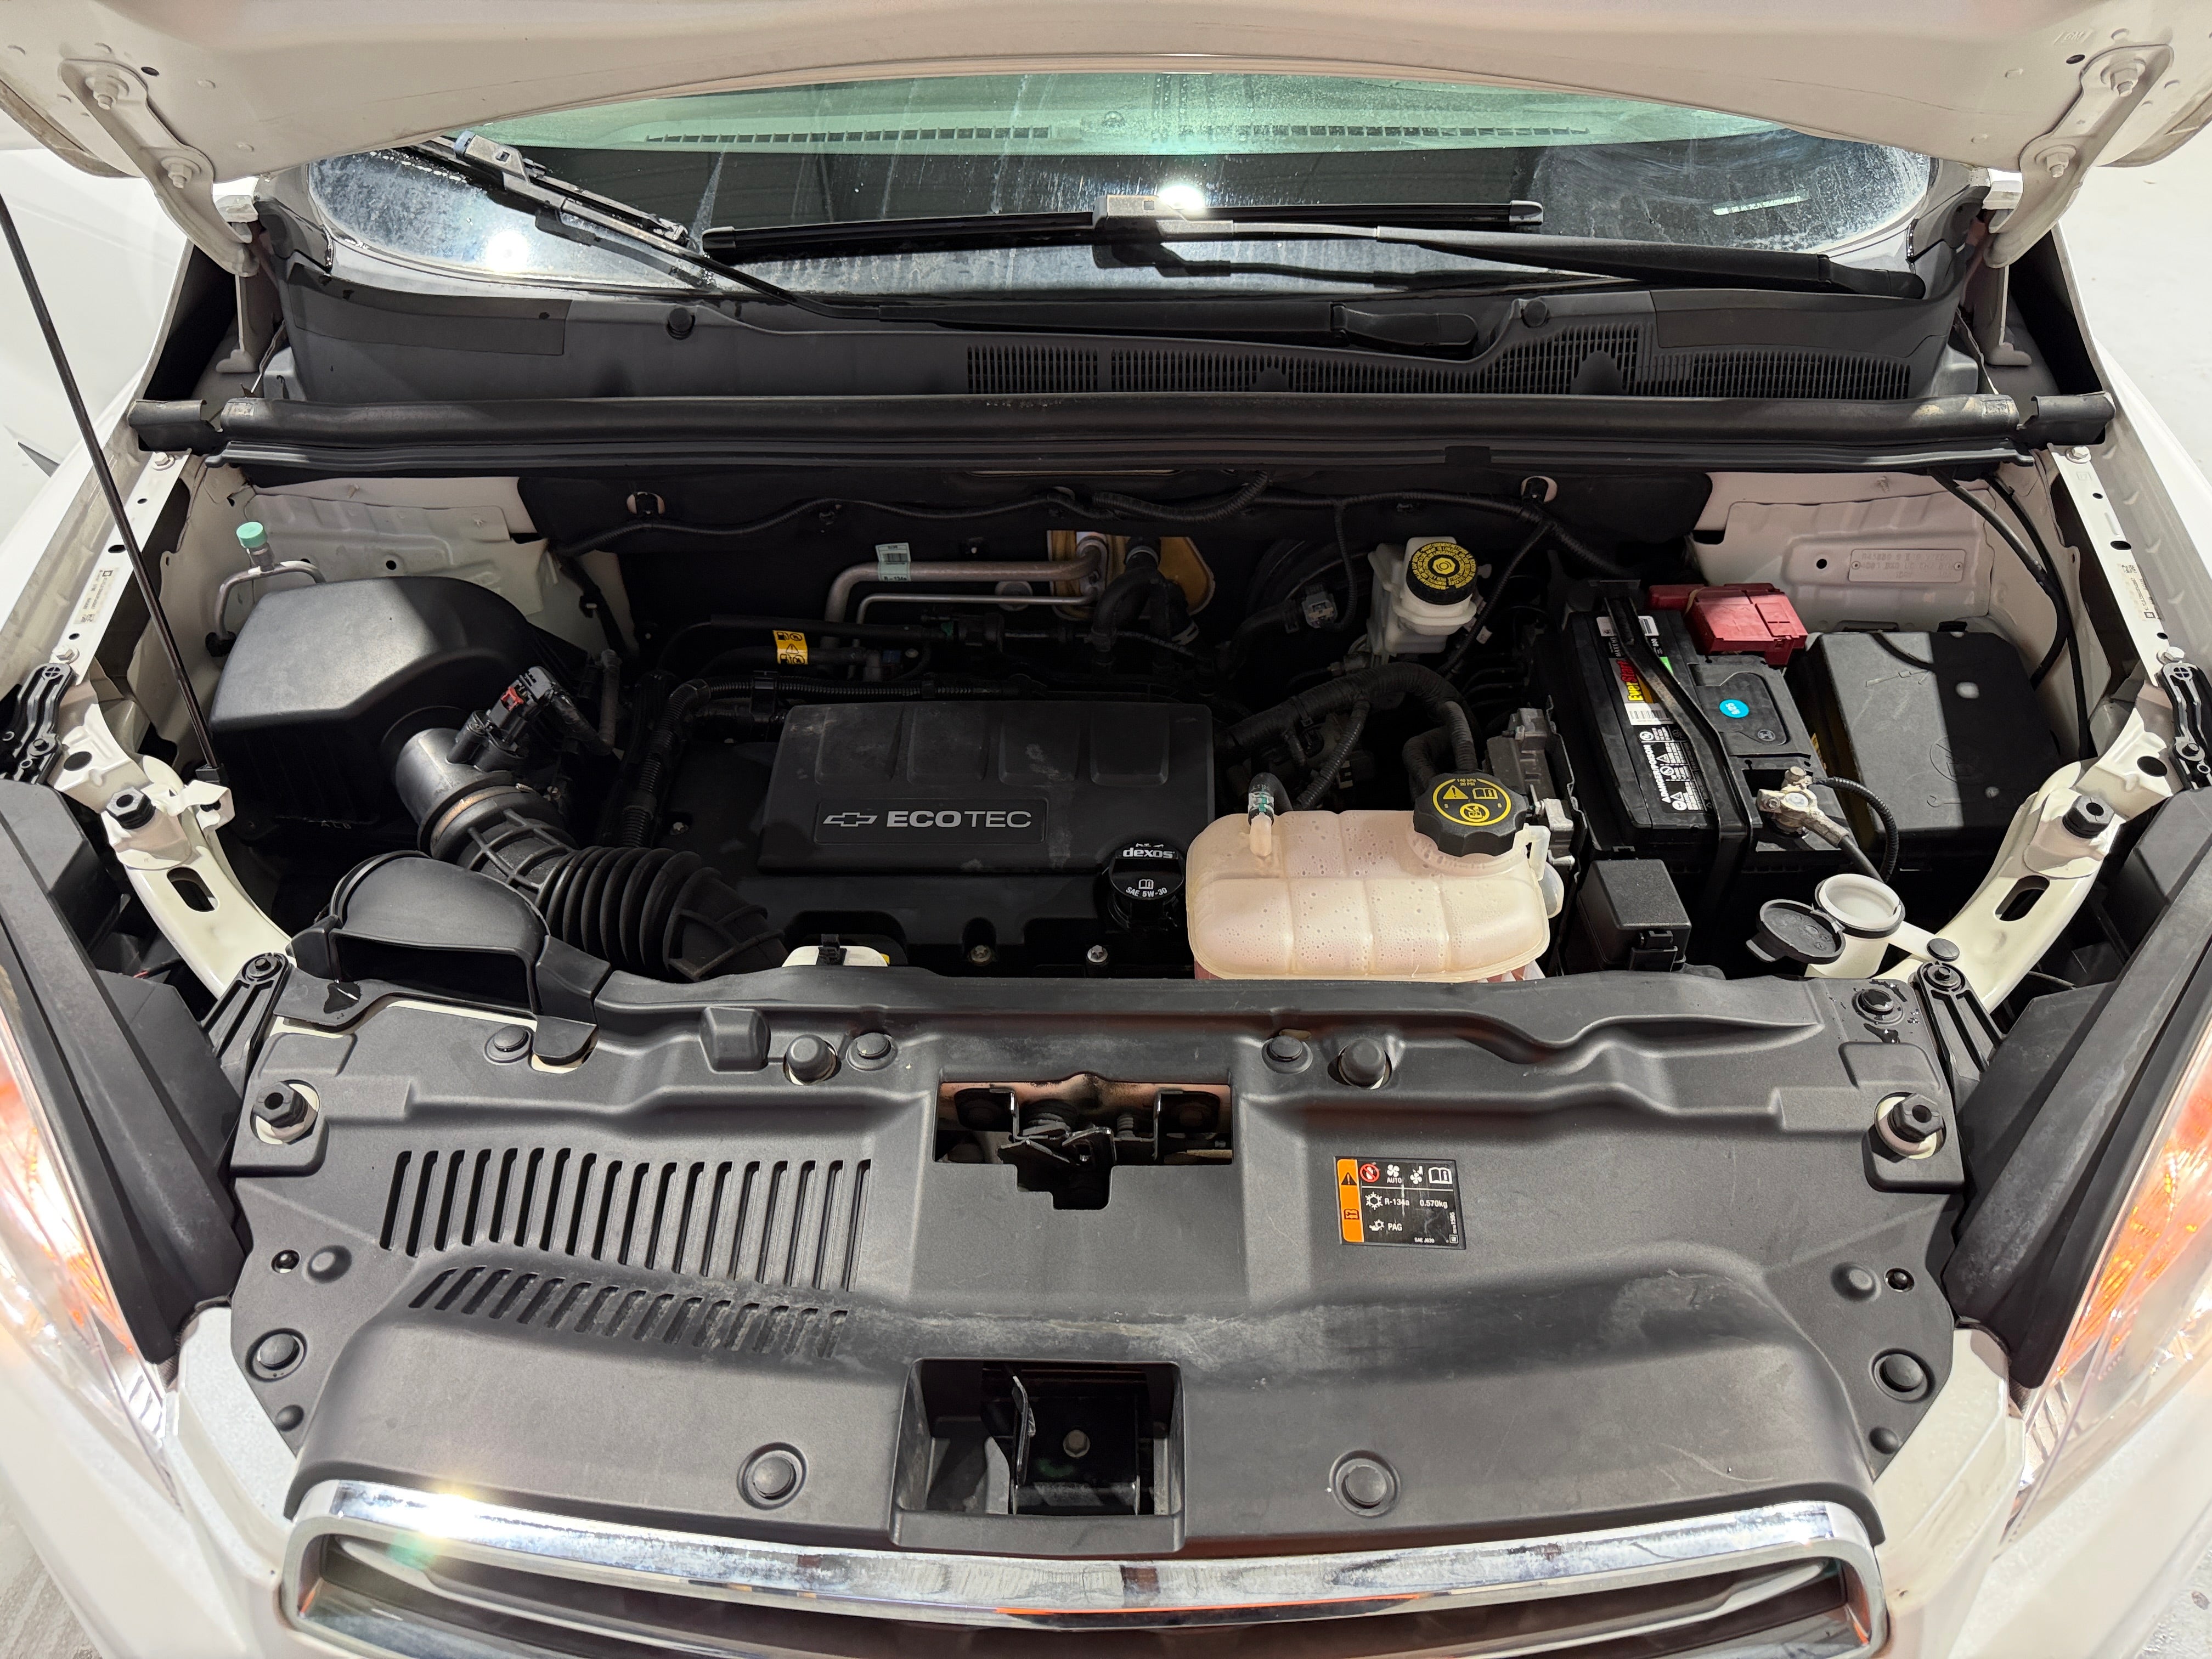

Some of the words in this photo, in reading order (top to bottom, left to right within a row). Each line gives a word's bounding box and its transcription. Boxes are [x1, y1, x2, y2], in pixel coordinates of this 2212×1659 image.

[1616, 659, 1644, 701] EverStart
[1643, 744, 1669, 797] DANGER/POISON
[887, 810, 1031, 828] ECOTEC
[1126, 887, 1140, 896] SAE
[1142, 887, 1167, 898] 5W-30
[1384, 1198, 1410, 1206] R-134a
